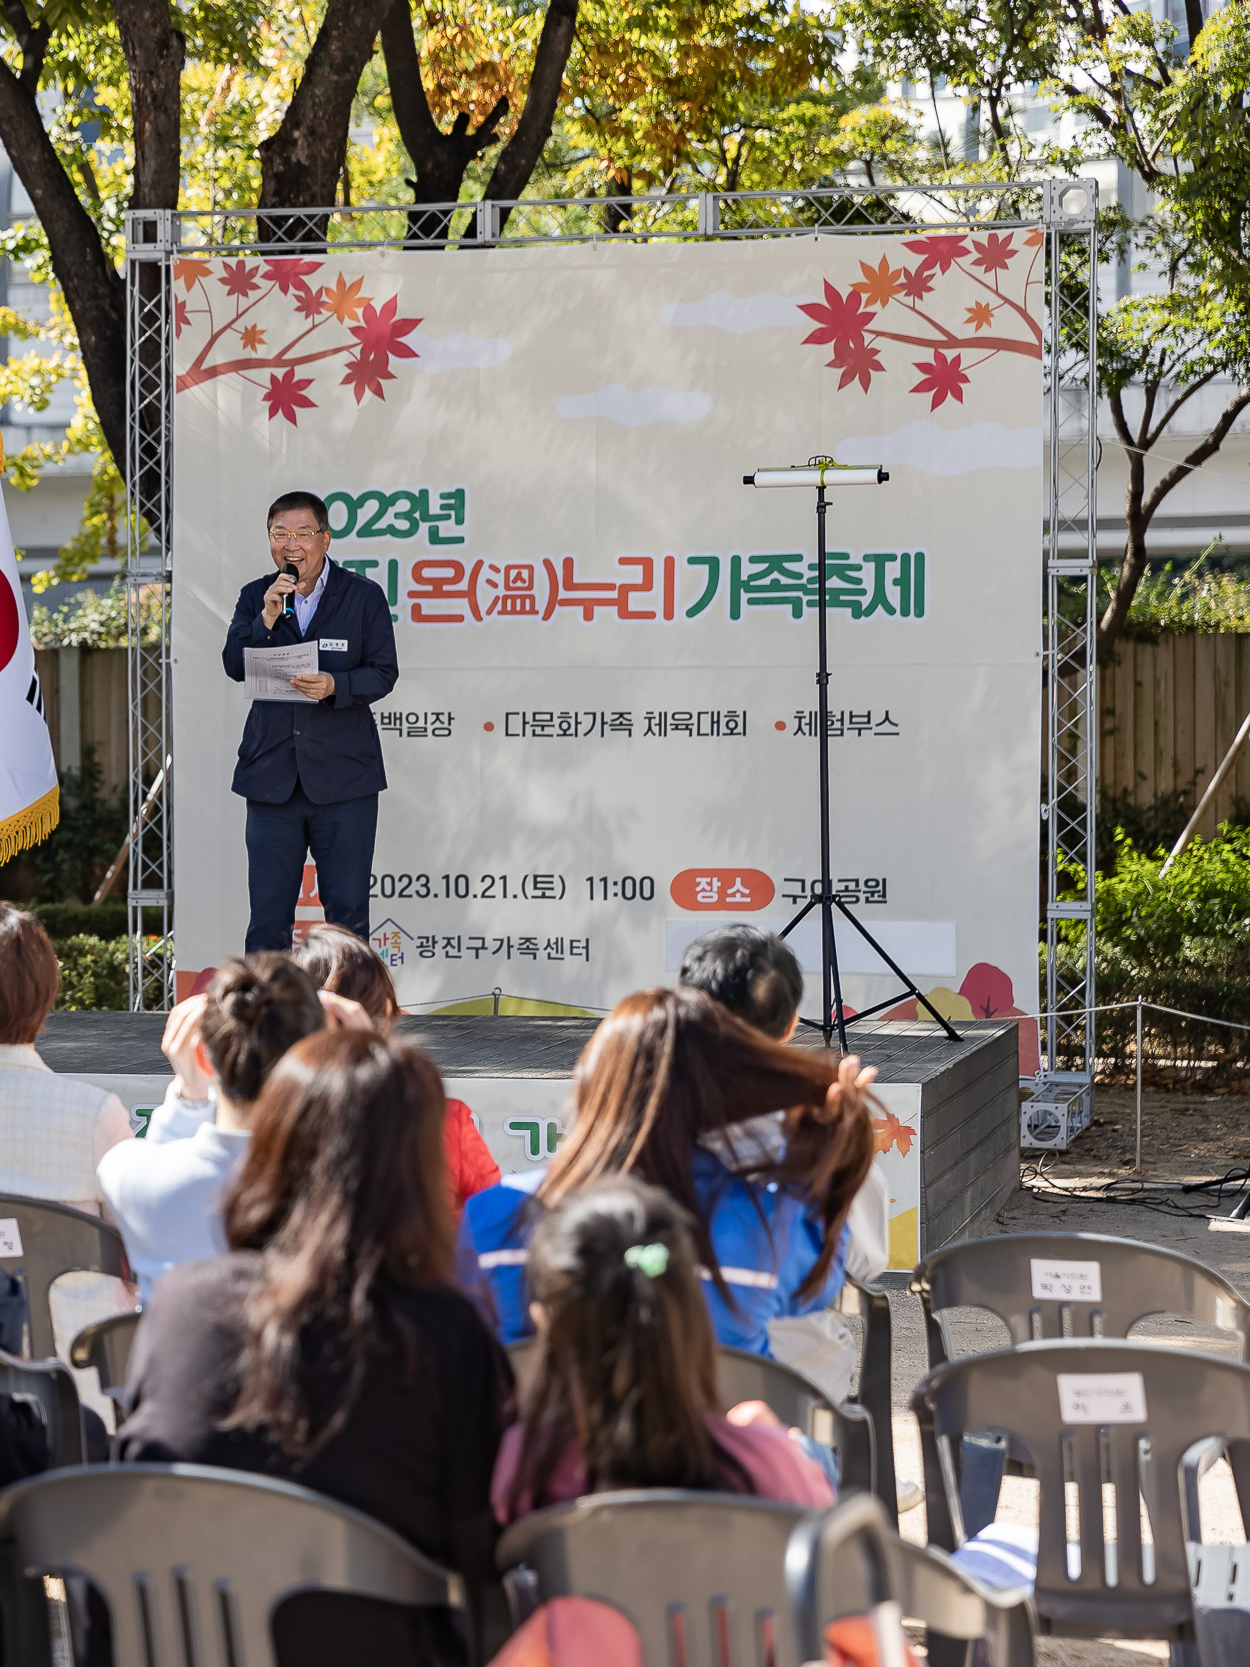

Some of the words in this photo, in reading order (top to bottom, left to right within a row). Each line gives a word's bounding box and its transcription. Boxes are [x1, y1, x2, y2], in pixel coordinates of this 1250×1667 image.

[321, 488, 466, 545] 023년
[685, 552, 926, 620] 가족축제
[504, 711, 634, 738] 다문화가족
[643, 710, 748, 738] 체육대회
[792, 710, 901, 737] 체험부스
[586, 875, 655, 901] 11:00
[694, 876, 752, 903] 장소
[415, 934, 591, 962] 광진구가족센터
